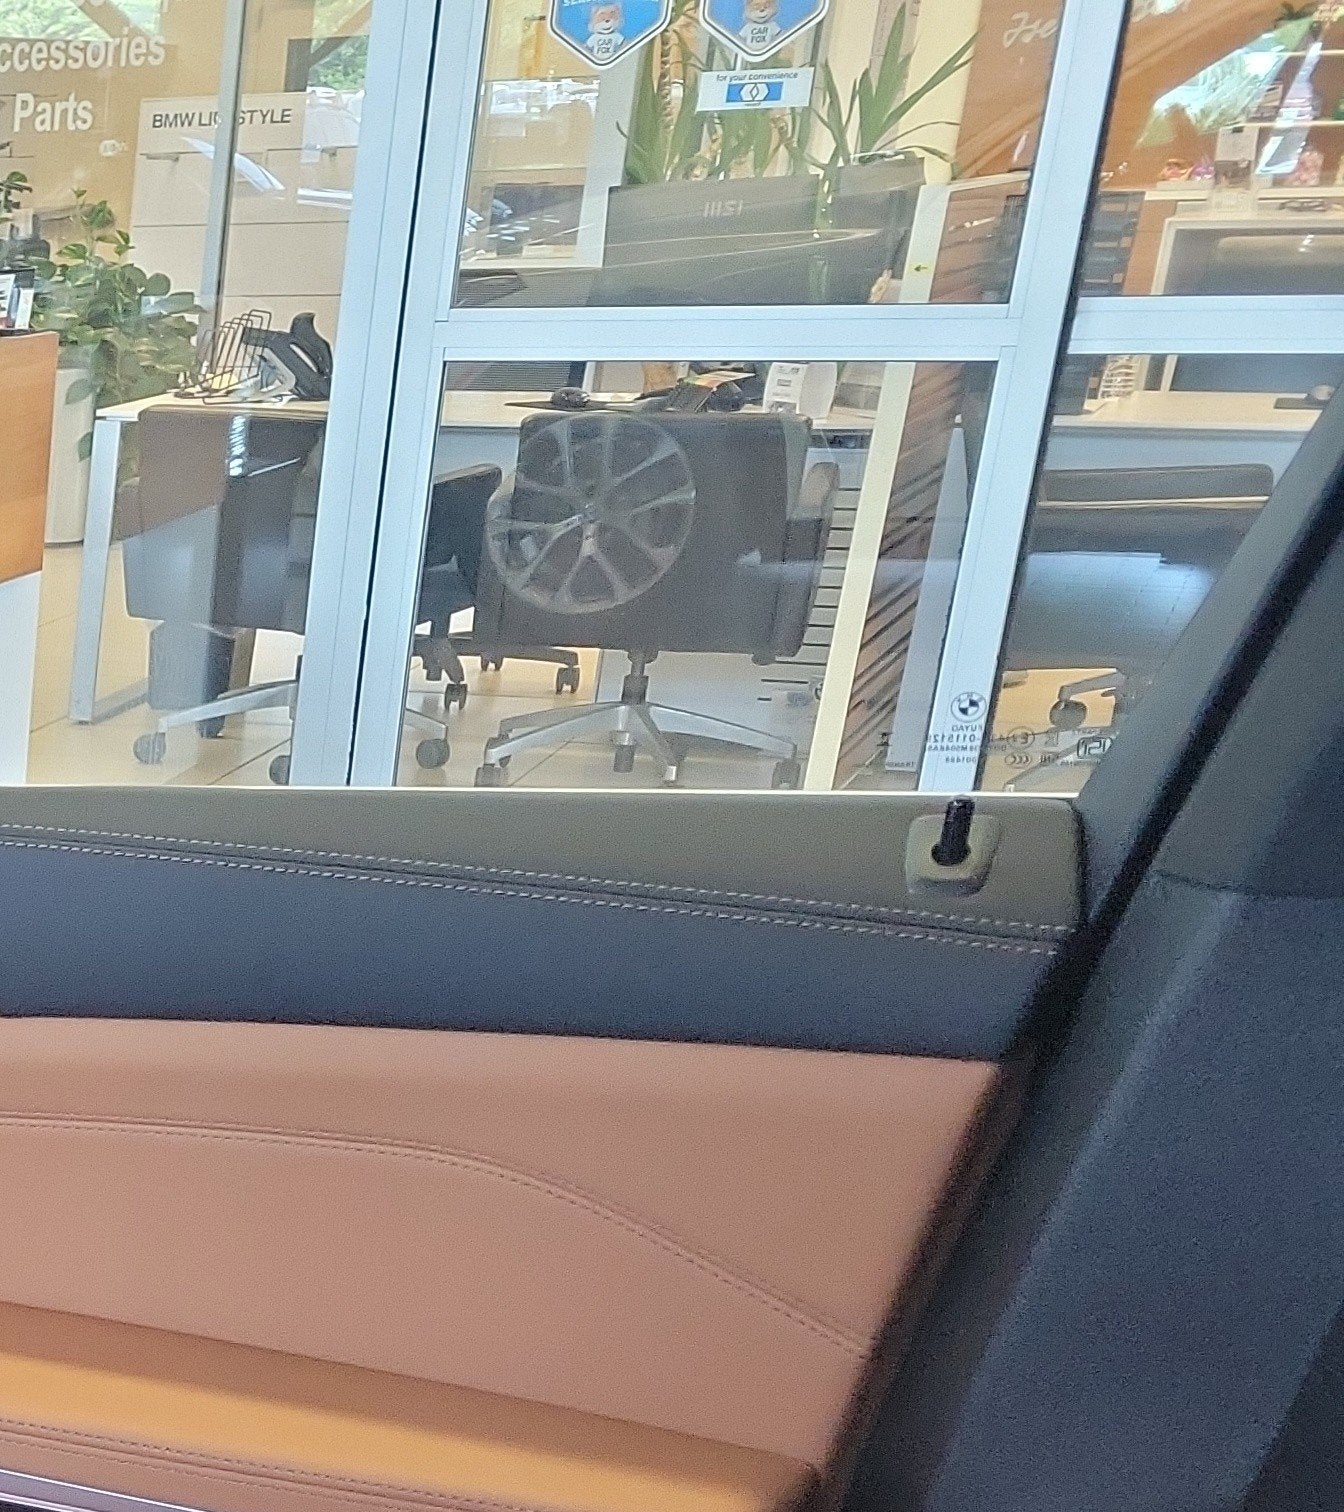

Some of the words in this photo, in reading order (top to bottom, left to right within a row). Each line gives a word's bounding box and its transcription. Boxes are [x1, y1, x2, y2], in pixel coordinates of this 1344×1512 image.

[729, 74, 747, 82] your
[749, 72, 799, 80] convenience
[14, 92, 94, 132] Parts
[152, 112, 195, 128] BMW
[198, 108, 293, 127] LISTYLE
